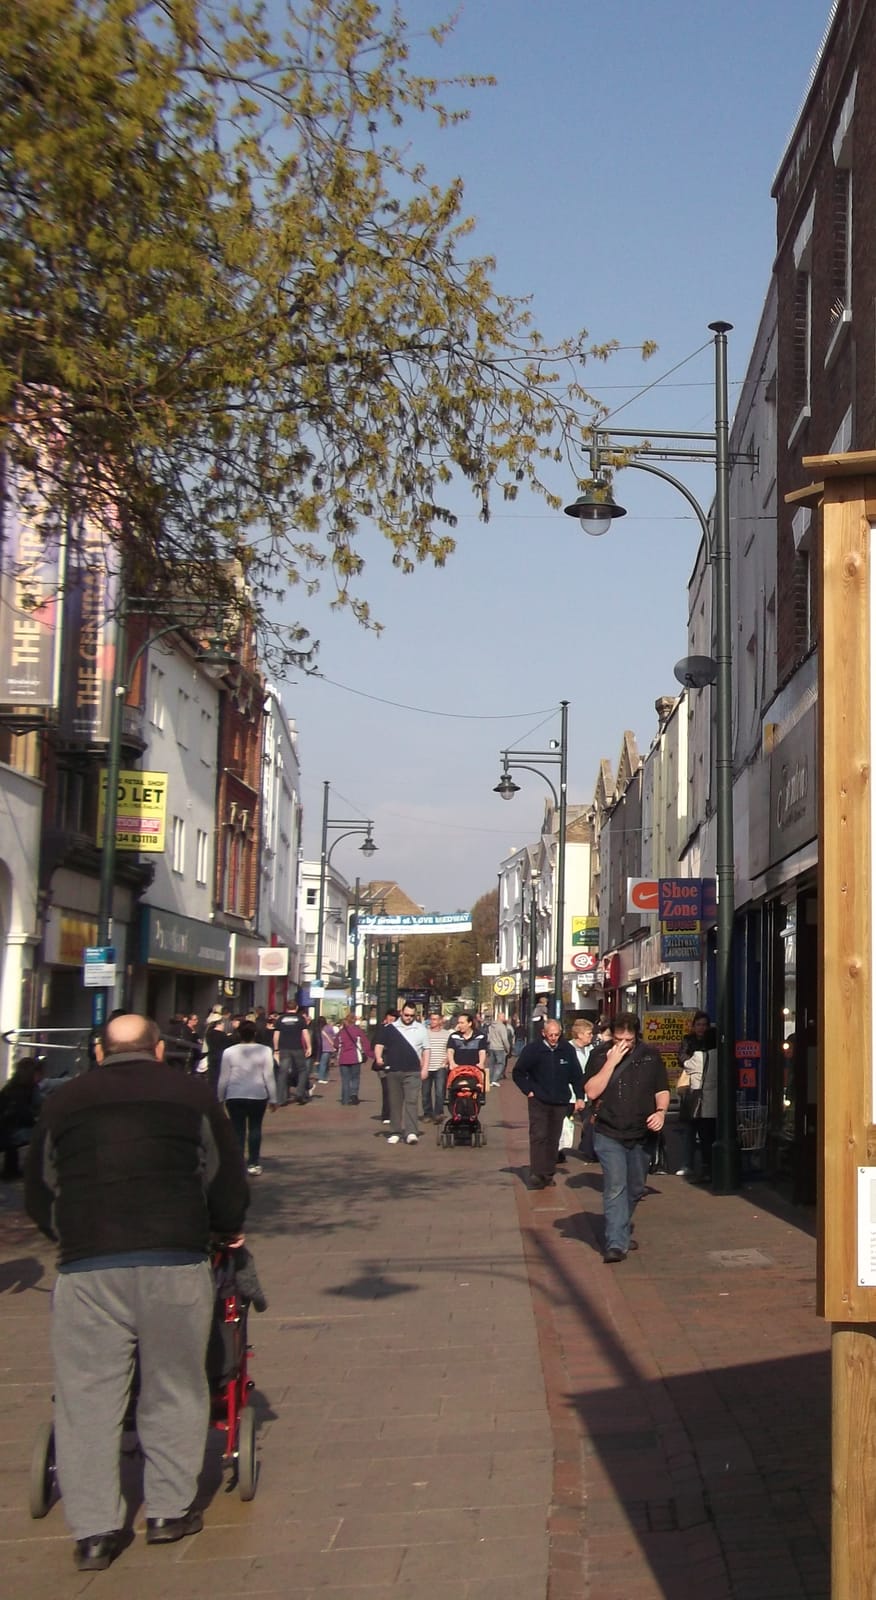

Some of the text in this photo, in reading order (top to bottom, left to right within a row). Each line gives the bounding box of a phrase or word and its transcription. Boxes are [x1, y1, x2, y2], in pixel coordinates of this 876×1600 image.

[12, 620, 41, 667] THE
[76, 667, 102, 708] THE
[132, 787, 164, 803] LET
[662, 880, 698, 898] Shoe
[663, 900, 698, 917] Zone
